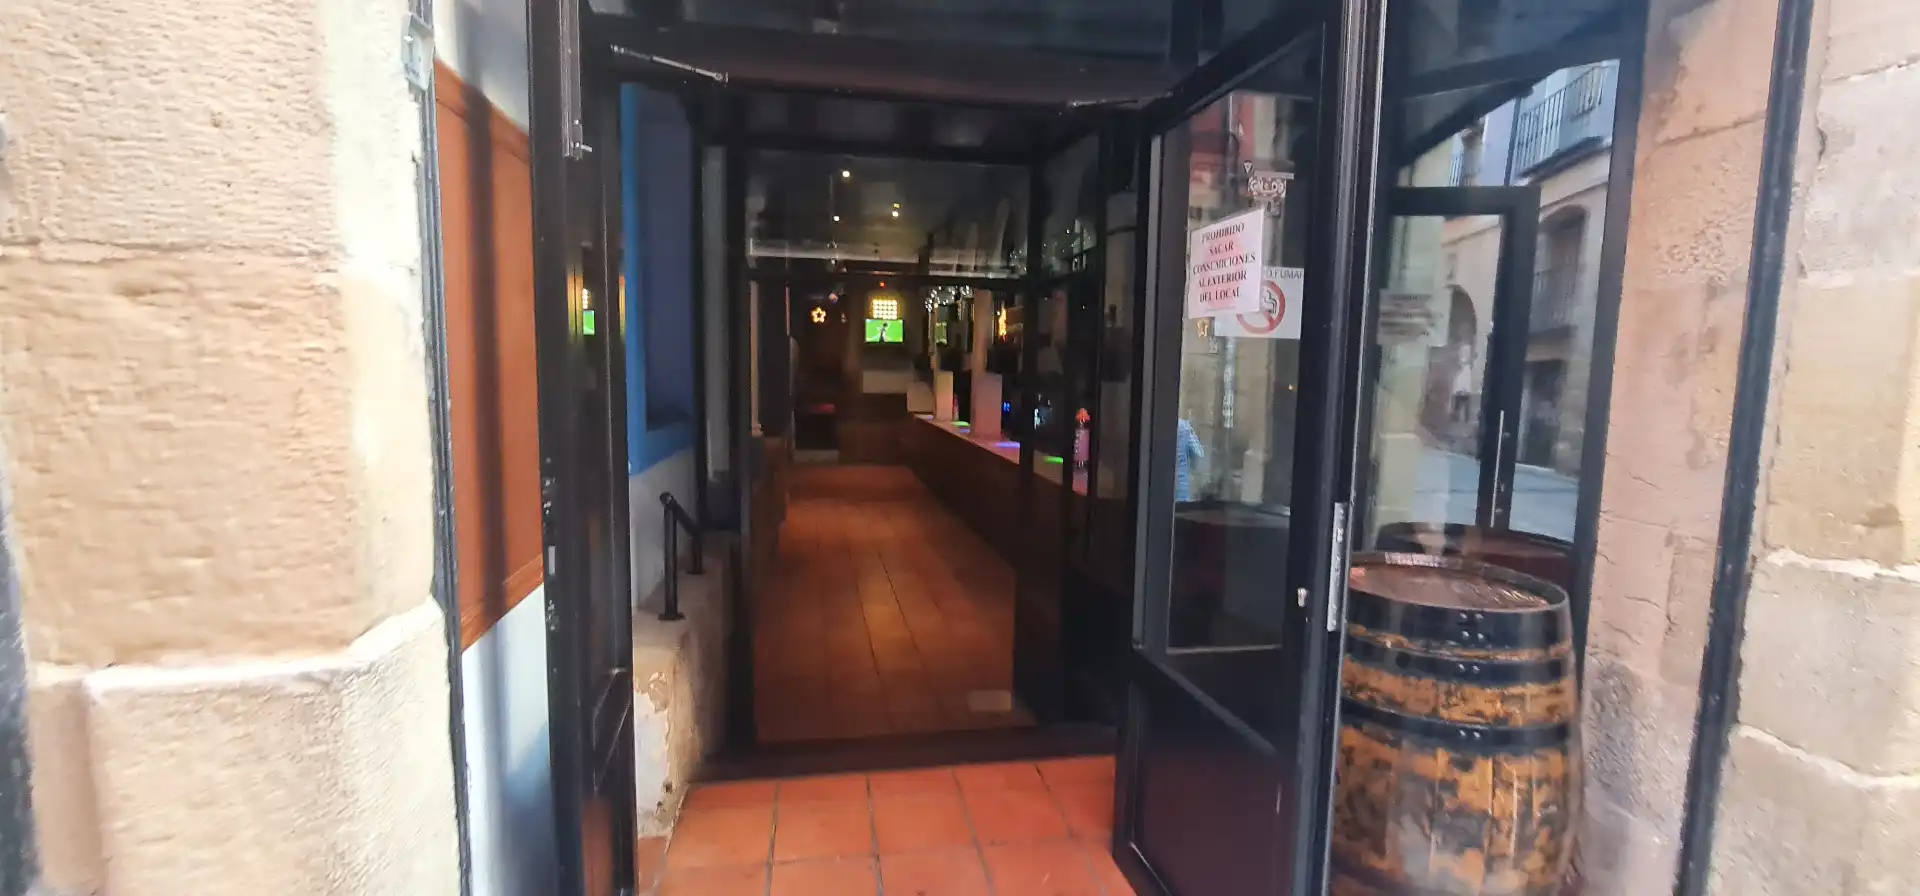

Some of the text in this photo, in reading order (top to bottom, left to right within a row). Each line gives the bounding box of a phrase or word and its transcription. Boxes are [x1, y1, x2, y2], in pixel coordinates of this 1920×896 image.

[1201, 222, 1245, 244] PROHIBIDO
[1209, 240, 1234, 256] SACAR
[1193, 252, 1257, 275] CONSUMICIONES
[1199, 269, 1247, 287] AL EXTERIOR
[1200, 286, 1240, 303] DEL LOCAL
